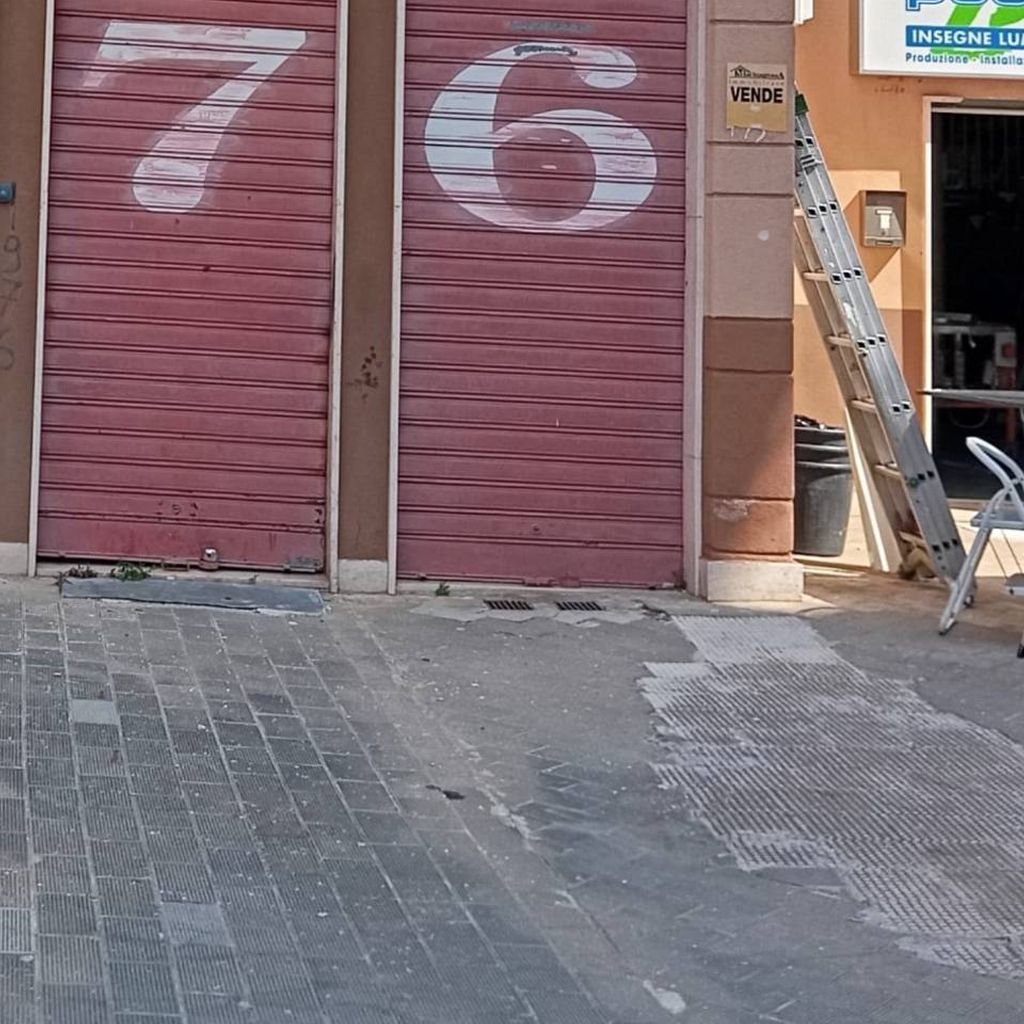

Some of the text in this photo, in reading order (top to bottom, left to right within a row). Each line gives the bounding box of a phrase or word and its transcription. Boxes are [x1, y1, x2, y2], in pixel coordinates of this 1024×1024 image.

[911, 29, 1024, 46] INSEGNE LU
[905, 52, 969, 64] Produzione
[730, 86, 784, 104] VENDE
